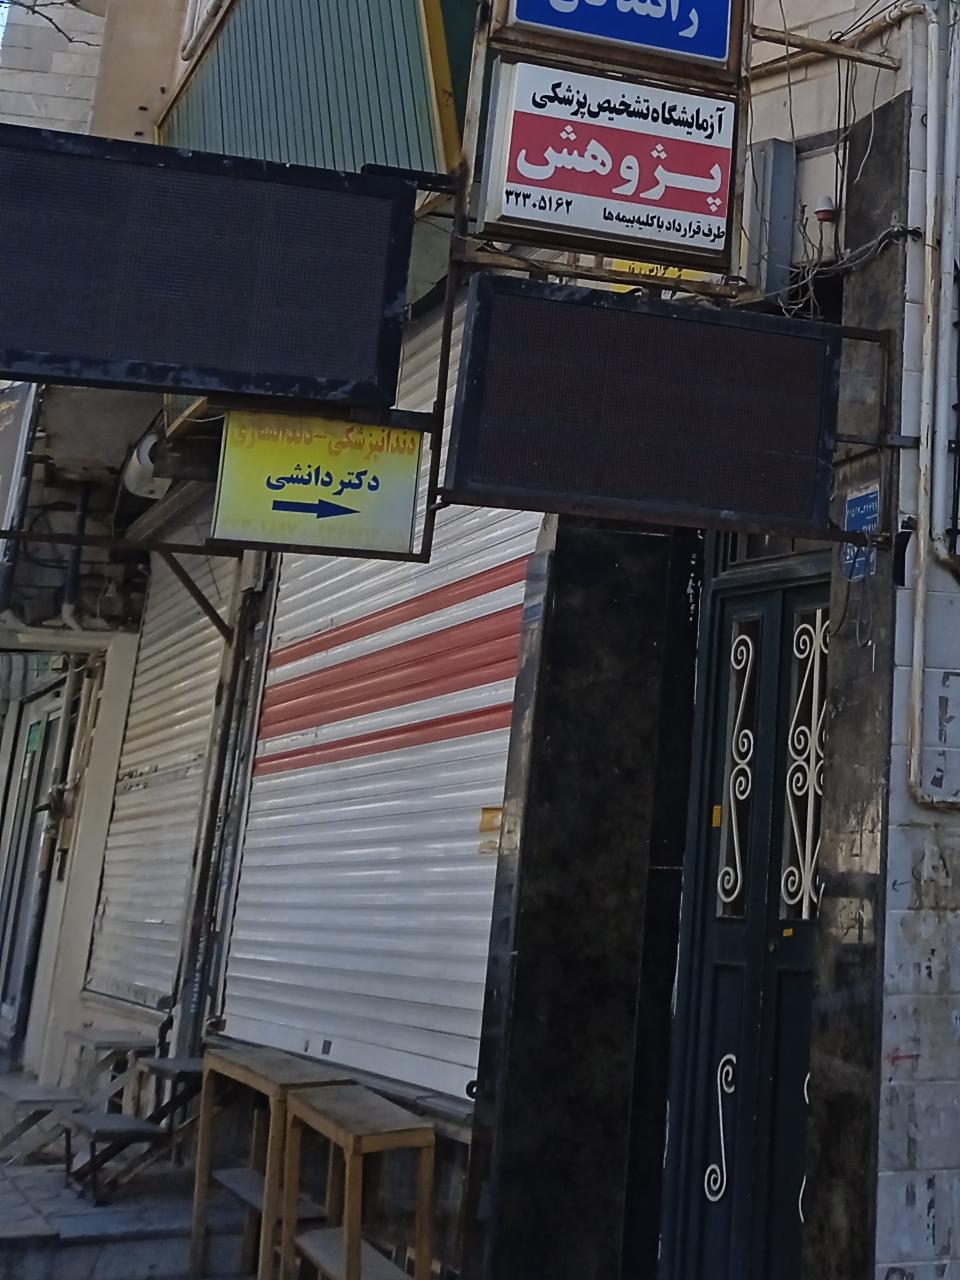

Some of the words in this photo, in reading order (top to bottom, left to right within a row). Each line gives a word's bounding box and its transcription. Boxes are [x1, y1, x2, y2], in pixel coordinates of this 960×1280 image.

[531, 81, 588, 119] پزشکی
[586, 94, 651, 122] تشخیص
[651, 101, 726, 140] آزمایشگاه
[516, 124, 723, 213] پژوهش
[504, 187, 573, 214] ۳۲۳۰۵۱۶۲
[602, 207, 615, 222] ها
[614, 210, 636, 228] بیمه
[635, 214, 656, 231] کلیه
[655, 215, 664, 232] با
[665, 218, 701, 239] قرارداد
[701, 225, 726, 243] طرف
[266, 464, 333, 491] دانشی
[332, 469, 380, 496] دکتر
